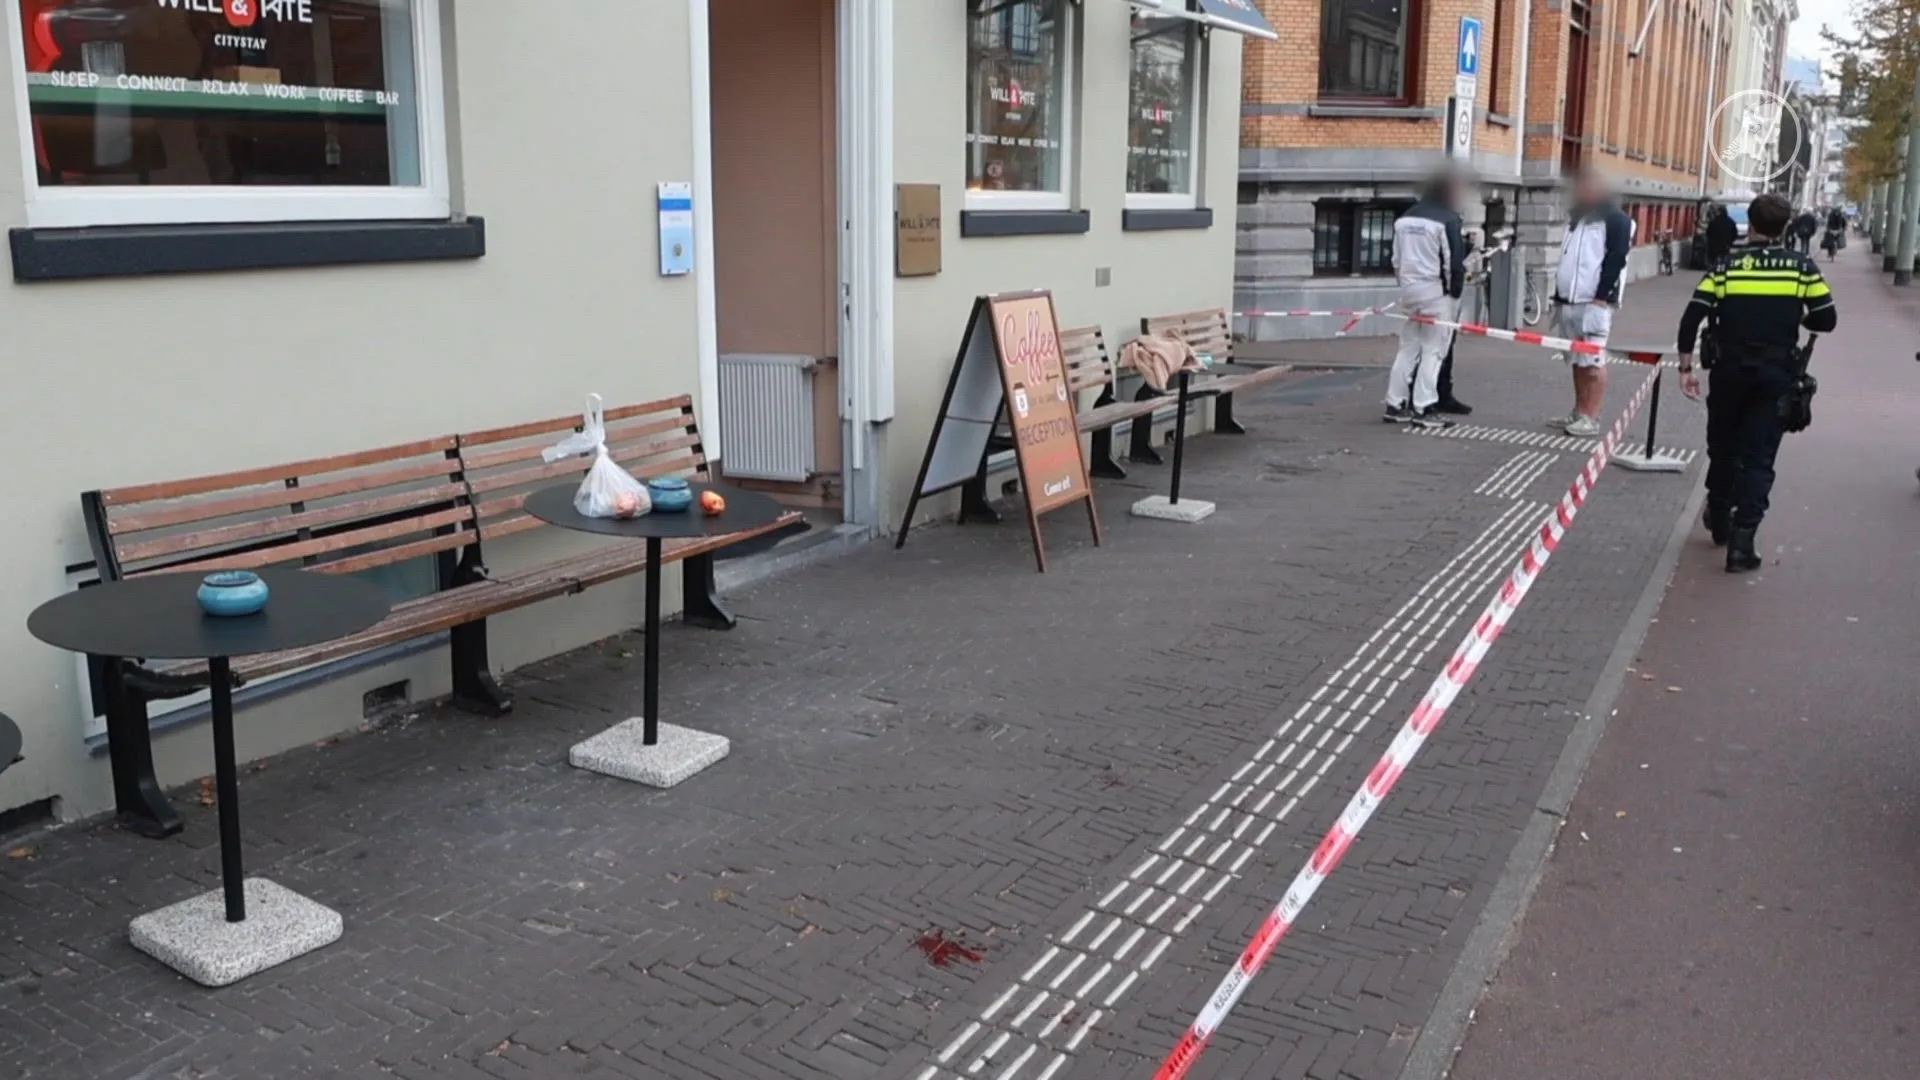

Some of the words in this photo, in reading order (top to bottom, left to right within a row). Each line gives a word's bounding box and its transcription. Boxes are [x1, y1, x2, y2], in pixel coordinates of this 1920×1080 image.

[231, 0, 248, 16] &
[214, 34, 267, 50] CITYSTAY
[51, 70, 99, 88] SLEEP
[116, 74, 187, 92] CONNECT
[202, 79, 249, 96] RELAX
[263, 83, 306, 100] WORK
[318, 87, 364, 103] COFFEE
[376, 91, 399, 105] BAR
[1002, 308, 1056, 386] Coffee
[1019, 418, 1073, 446] RECEPTION
